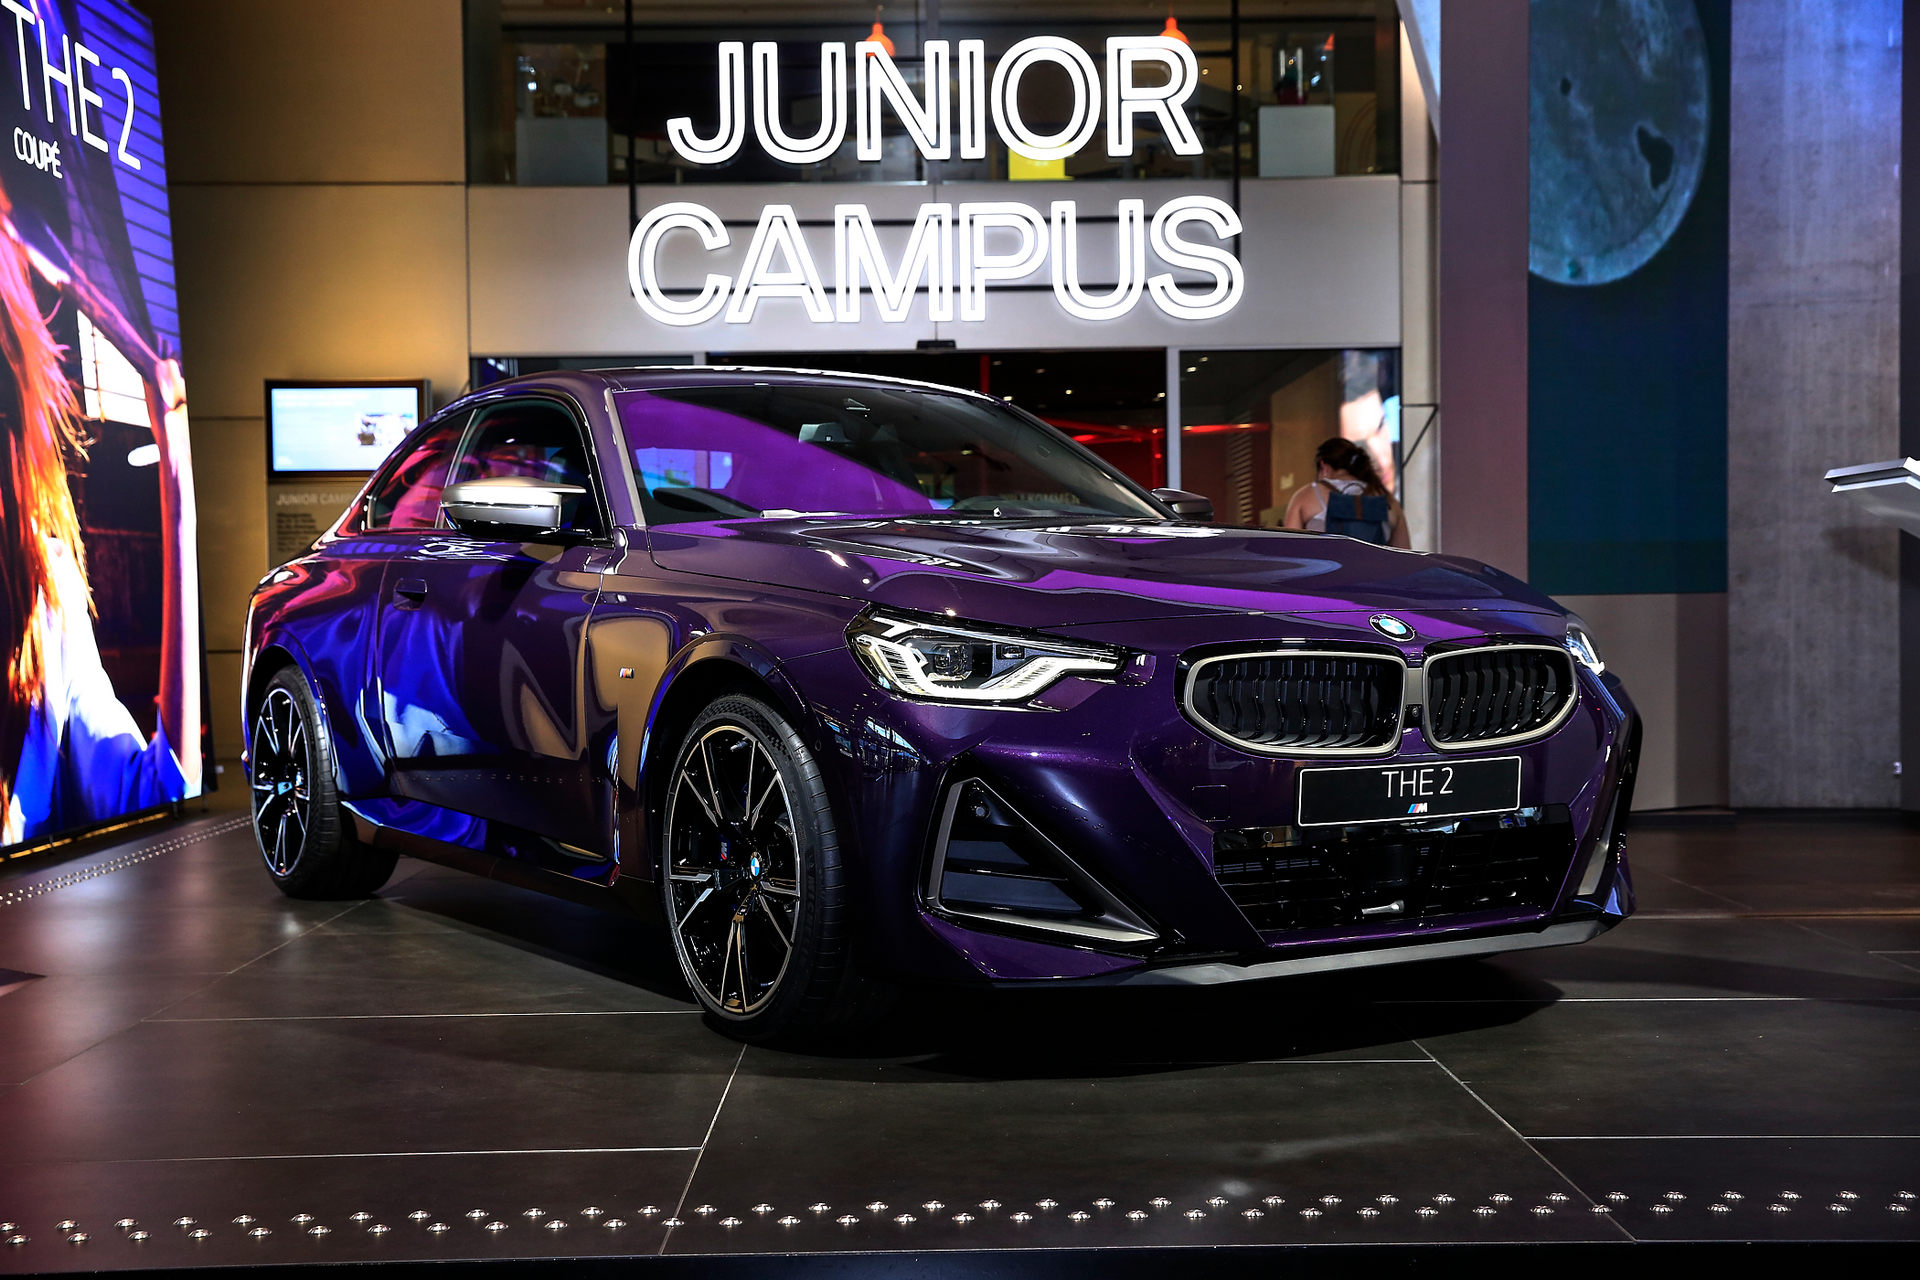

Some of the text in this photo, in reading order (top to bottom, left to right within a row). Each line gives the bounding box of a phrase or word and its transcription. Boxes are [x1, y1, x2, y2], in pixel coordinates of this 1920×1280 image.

[0, 0, 142, 170] THE 2
[666, 36, 1204, 164] JUNIOR
[13, 126, 63, 179] COUPÉ
[627, 195, 1245, 326] CAMPUS
[275, 493, 318, 506] JUNIOR
[1381, 766, 1454, 798] THE 2
